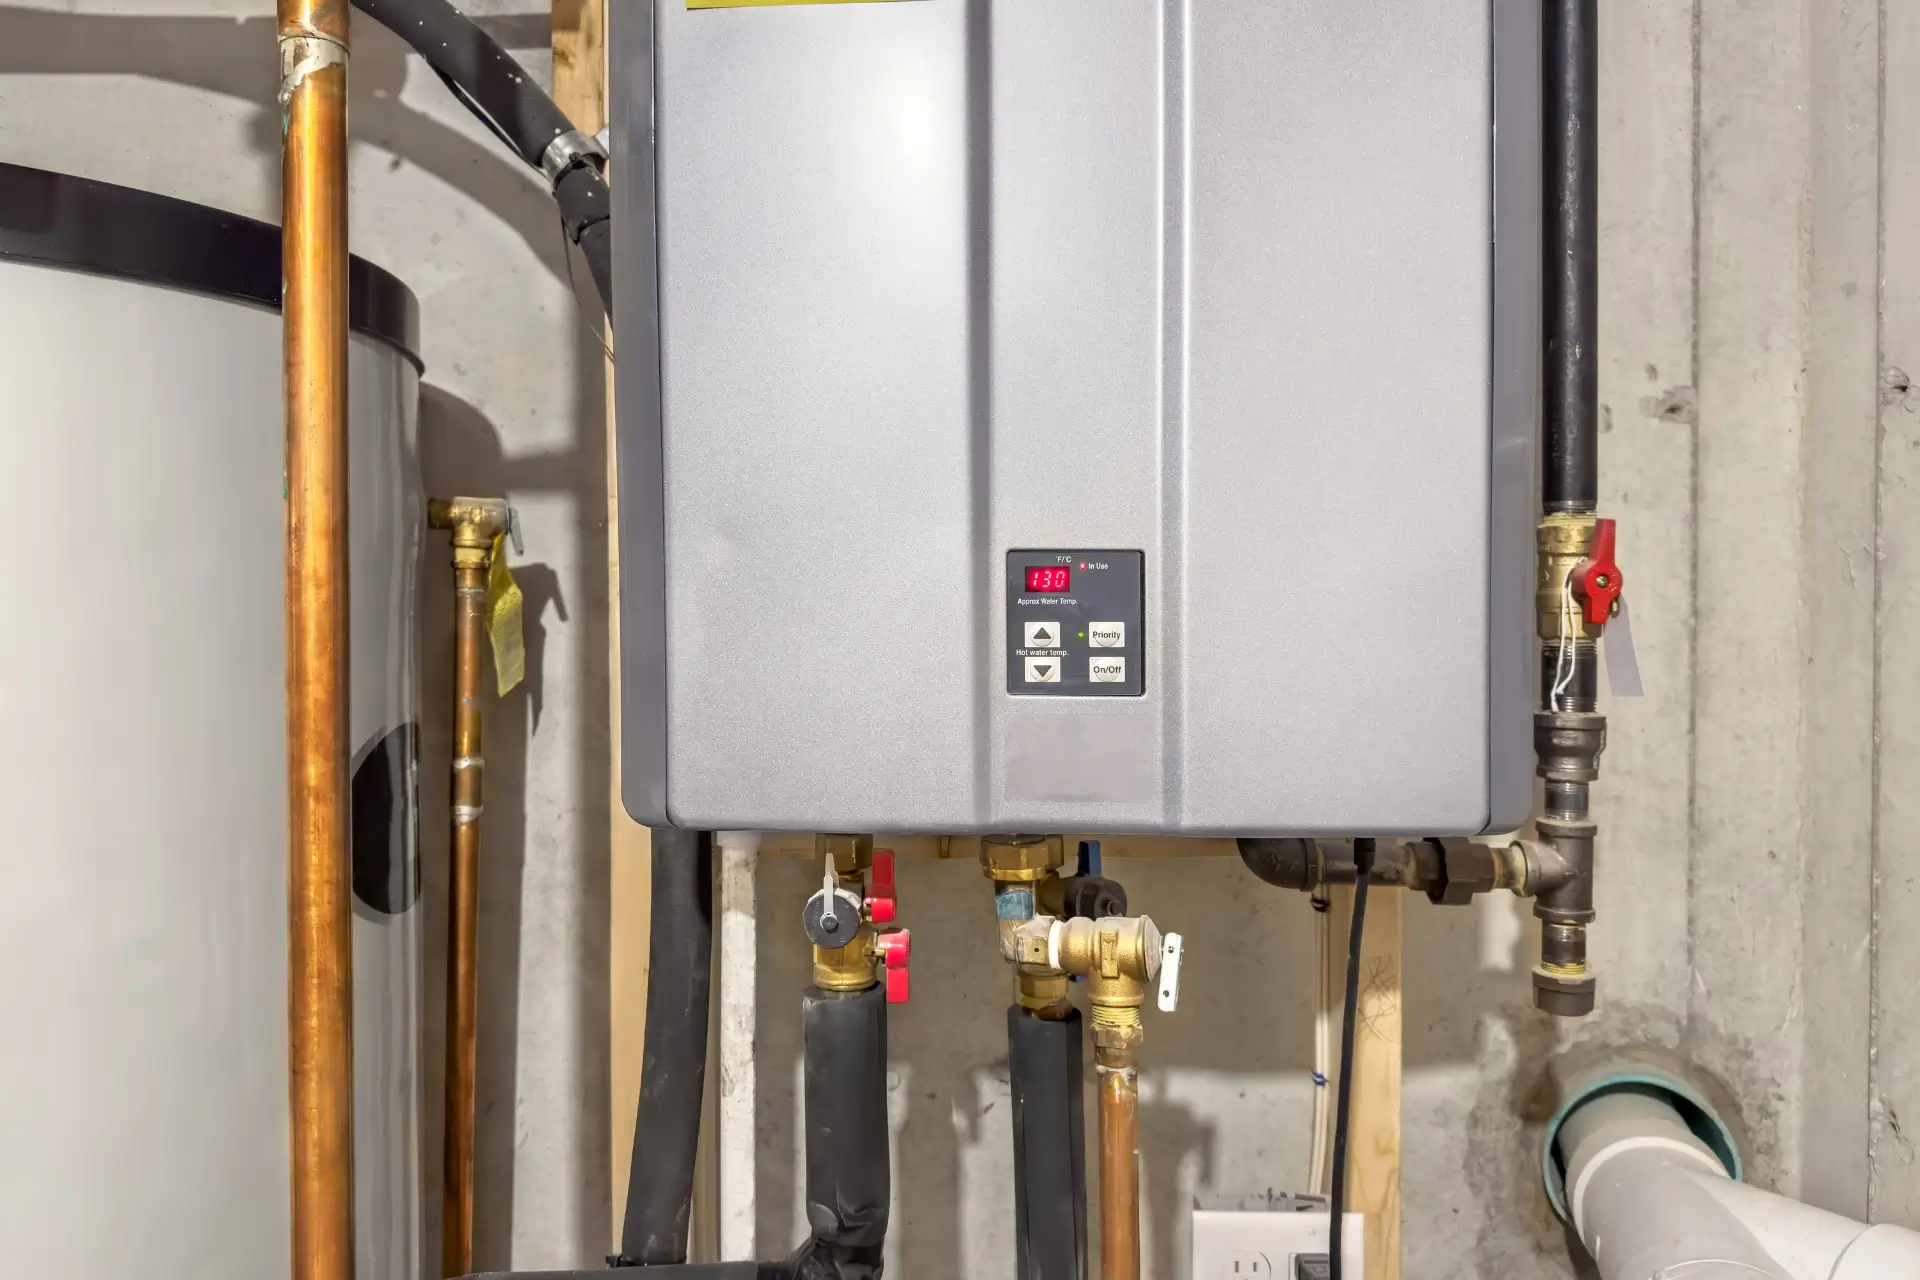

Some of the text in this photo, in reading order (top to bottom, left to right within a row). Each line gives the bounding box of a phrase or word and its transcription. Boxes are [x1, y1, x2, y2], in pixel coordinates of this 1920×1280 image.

[1033, 571, 1065, 588] 130
[1092, 631, 1121, 640] Priority
[1050, 649, 1068, 657] temp.
